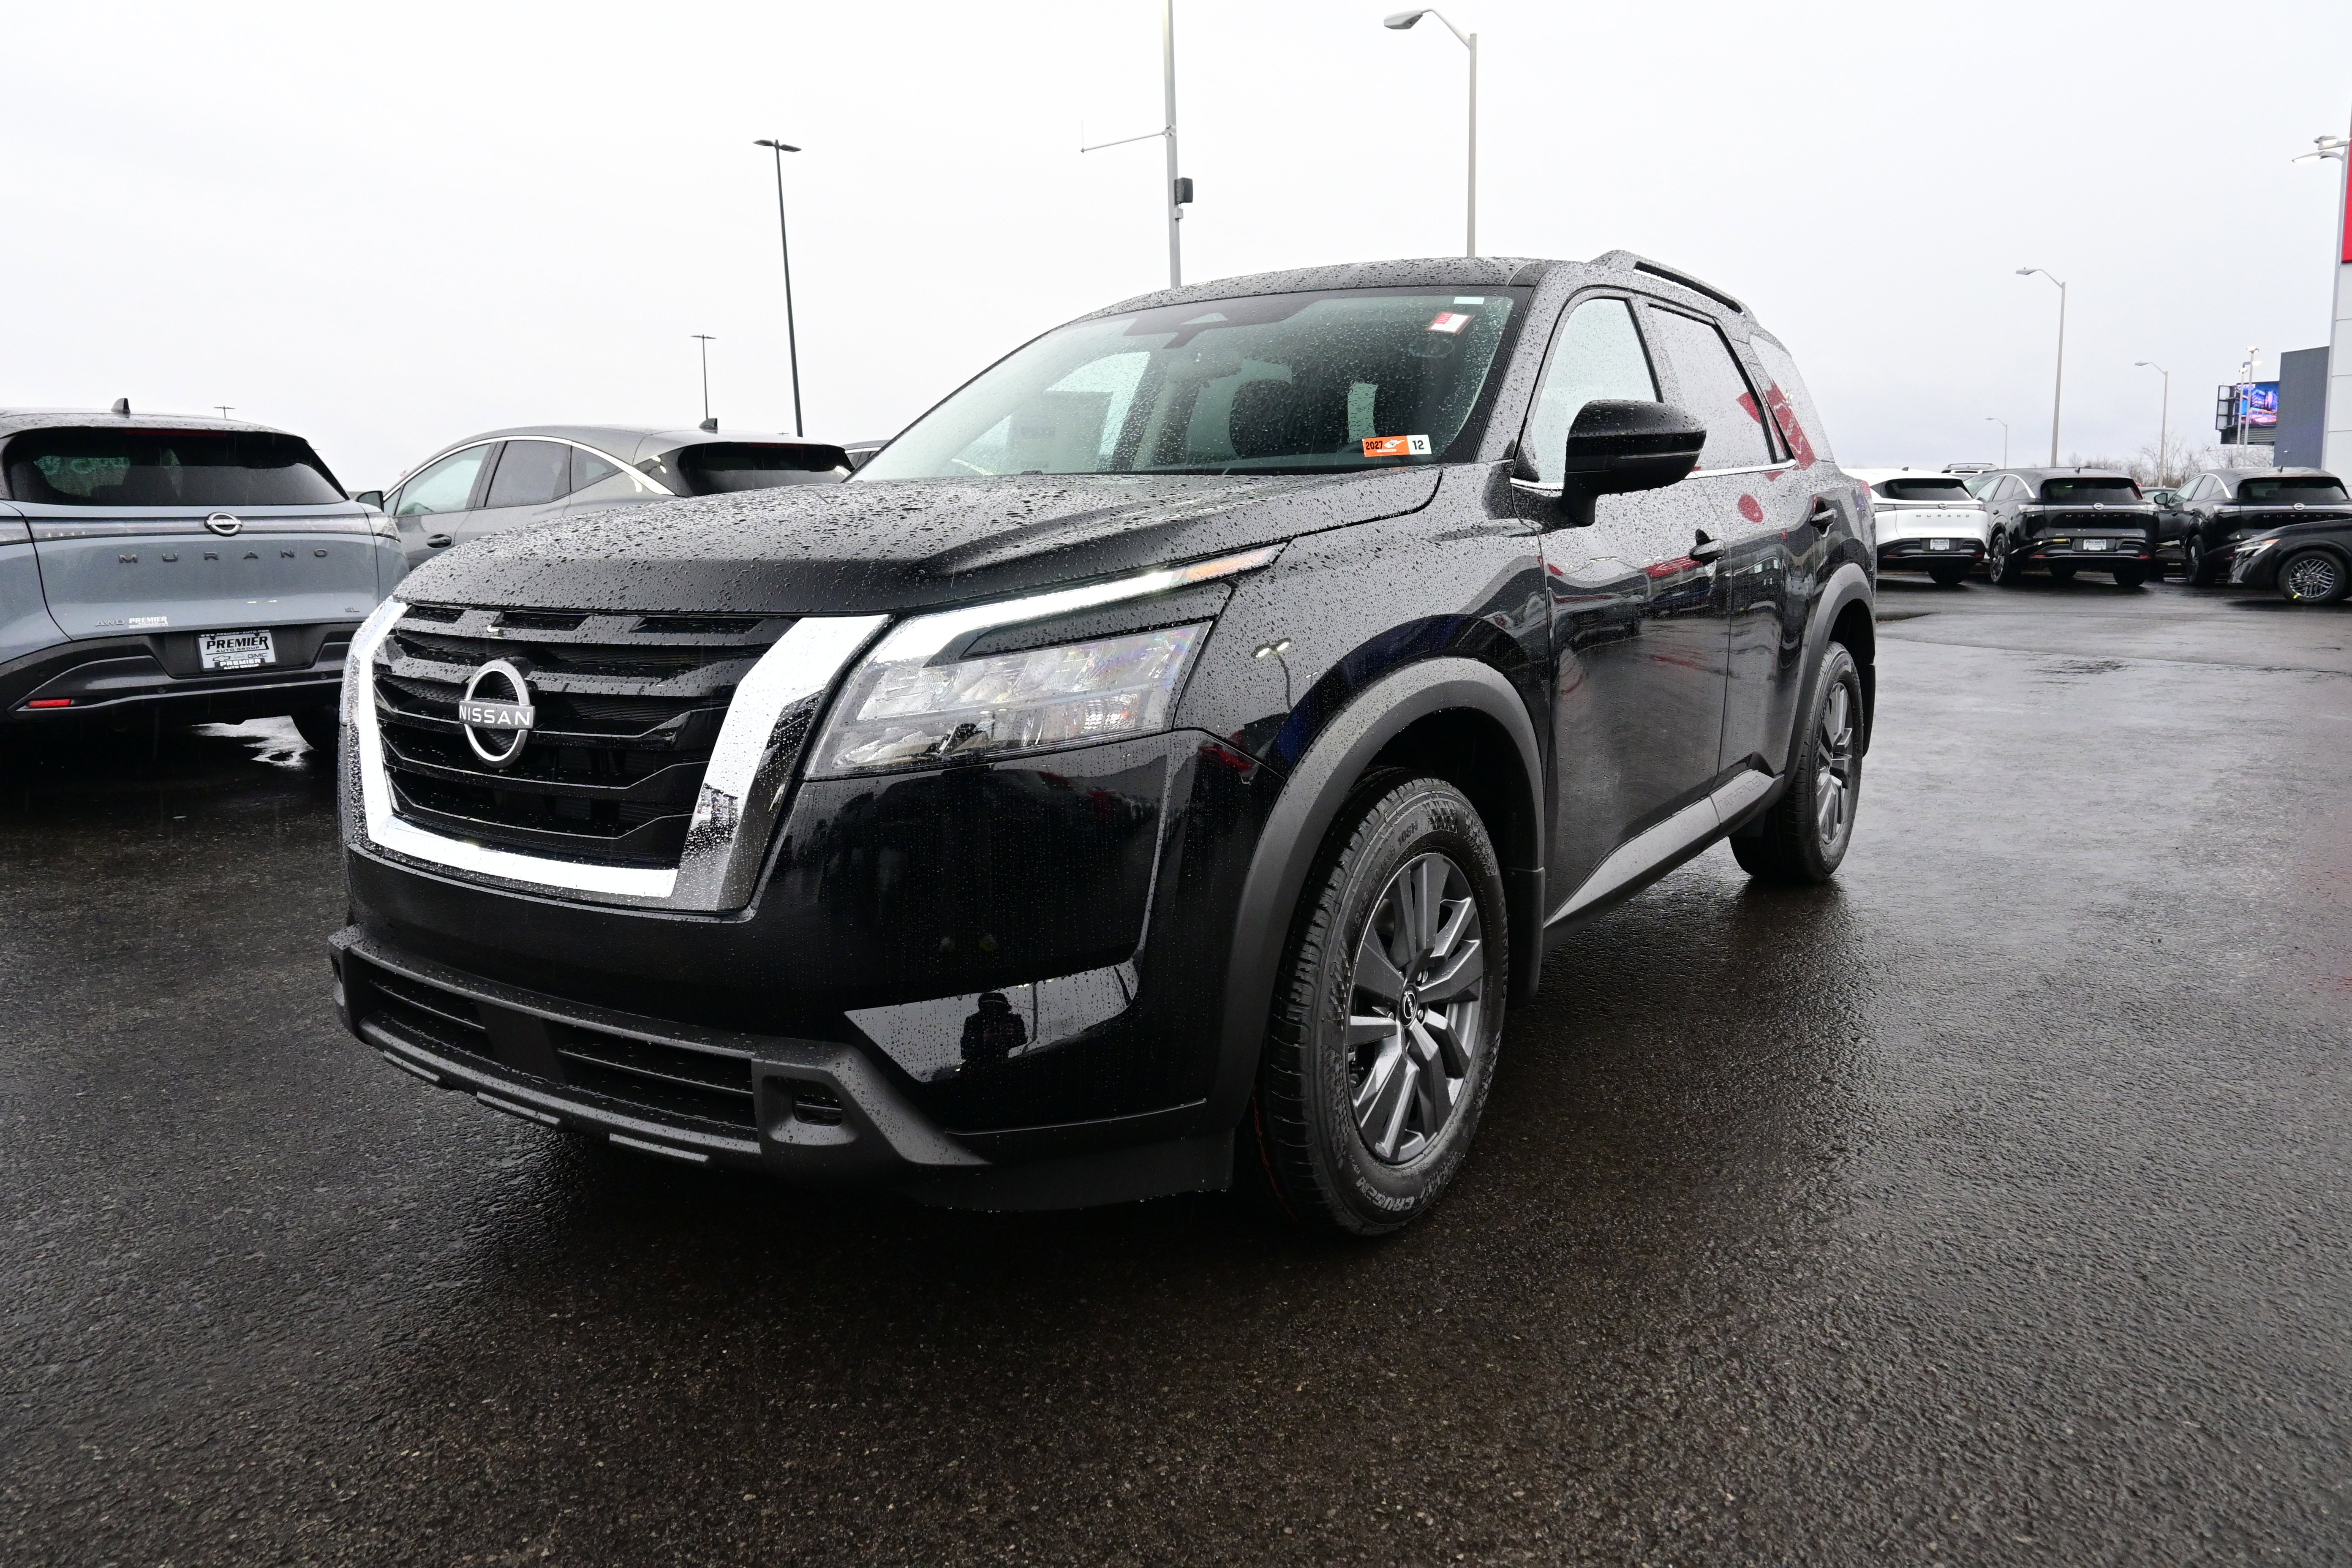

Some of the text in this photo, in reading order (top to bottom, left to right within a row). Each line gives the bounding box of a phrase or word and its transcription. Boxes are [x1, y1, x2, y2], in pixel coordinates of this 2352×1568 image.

[1365, 441, 1383, 450] 2027
[1412, 440, 1425, 450] 12
[119, 549, 328, 564] MURANO
[128, 616, 168, 624] PREMIER
[200, 629, 270, 637] WWW.PREMIER-AUTO.COM
[206, 636, 270, 650] PREMIER
[220, 658, 261, 667] PREMIER
[459, 705, 530, 726] NISSAN
[1356, 1176, 1415, 1211] CRUGEN
